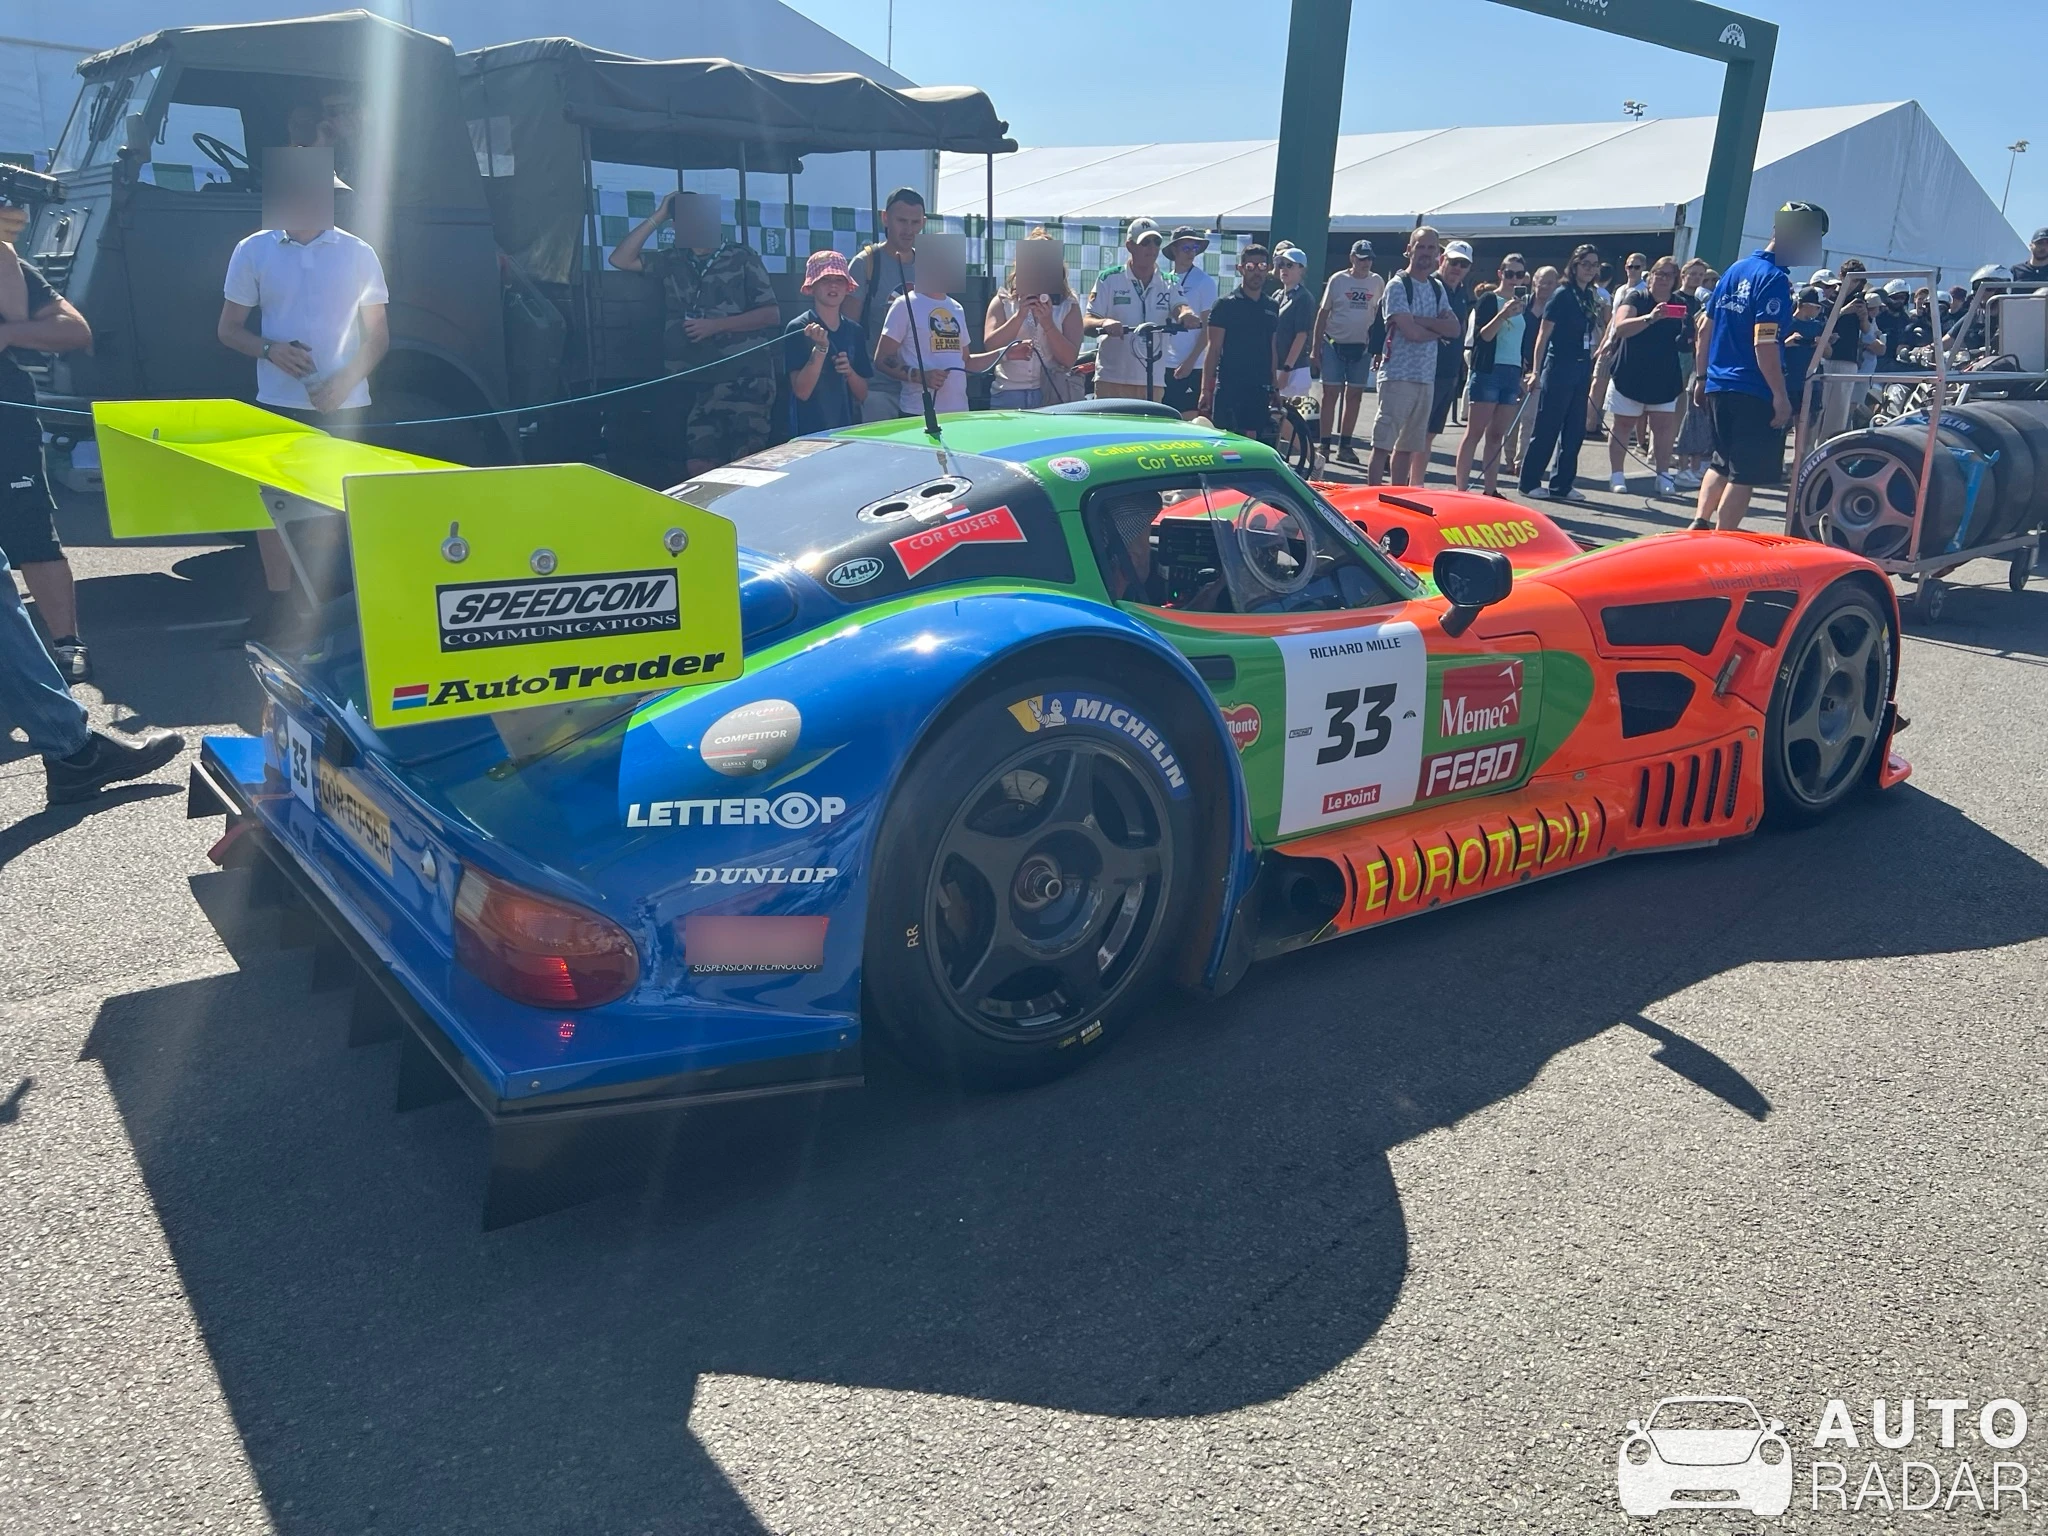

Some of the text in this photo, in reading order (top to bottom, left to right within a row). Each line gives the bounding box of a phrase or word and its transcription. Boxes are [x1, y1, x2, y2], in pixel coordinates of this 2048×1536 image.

[1351, 291, 1367, 301] 24
[1137, 453, 1215, 471] Cor Euser
[908, 514, 1001, 551] COR EUSER
[1440, 520, 1539, 549] MARCOS
[832, 559, 877, 585] Arai
[449, 579, 669, 625] SPEEDCOM
[444, 614, 677, 646] COMMUNICATIONS
[1310, 637, 1402, 660] RICHARD MILLE
[428, 652, 725, 707] AutoTrader
[1316, 683, 1398, 766] 33
[1440, 696, 1510, 738] Memec
[714, 729, 788, 745] COMPETITOR
[1072, 698, 1185, 789] MICHELIN
[292, 737, 308, 789] 33
[1426, 742, 1518, 797] FEBO
[626, 791, 846, 830] LETTEROP
[1327, 789, 1378, 811] Le Point
[690, 867, 838, 885] DUNLOP
[1365, 811, 1590, 911] EUROTECH
[906, 924, 919, 948] RR
